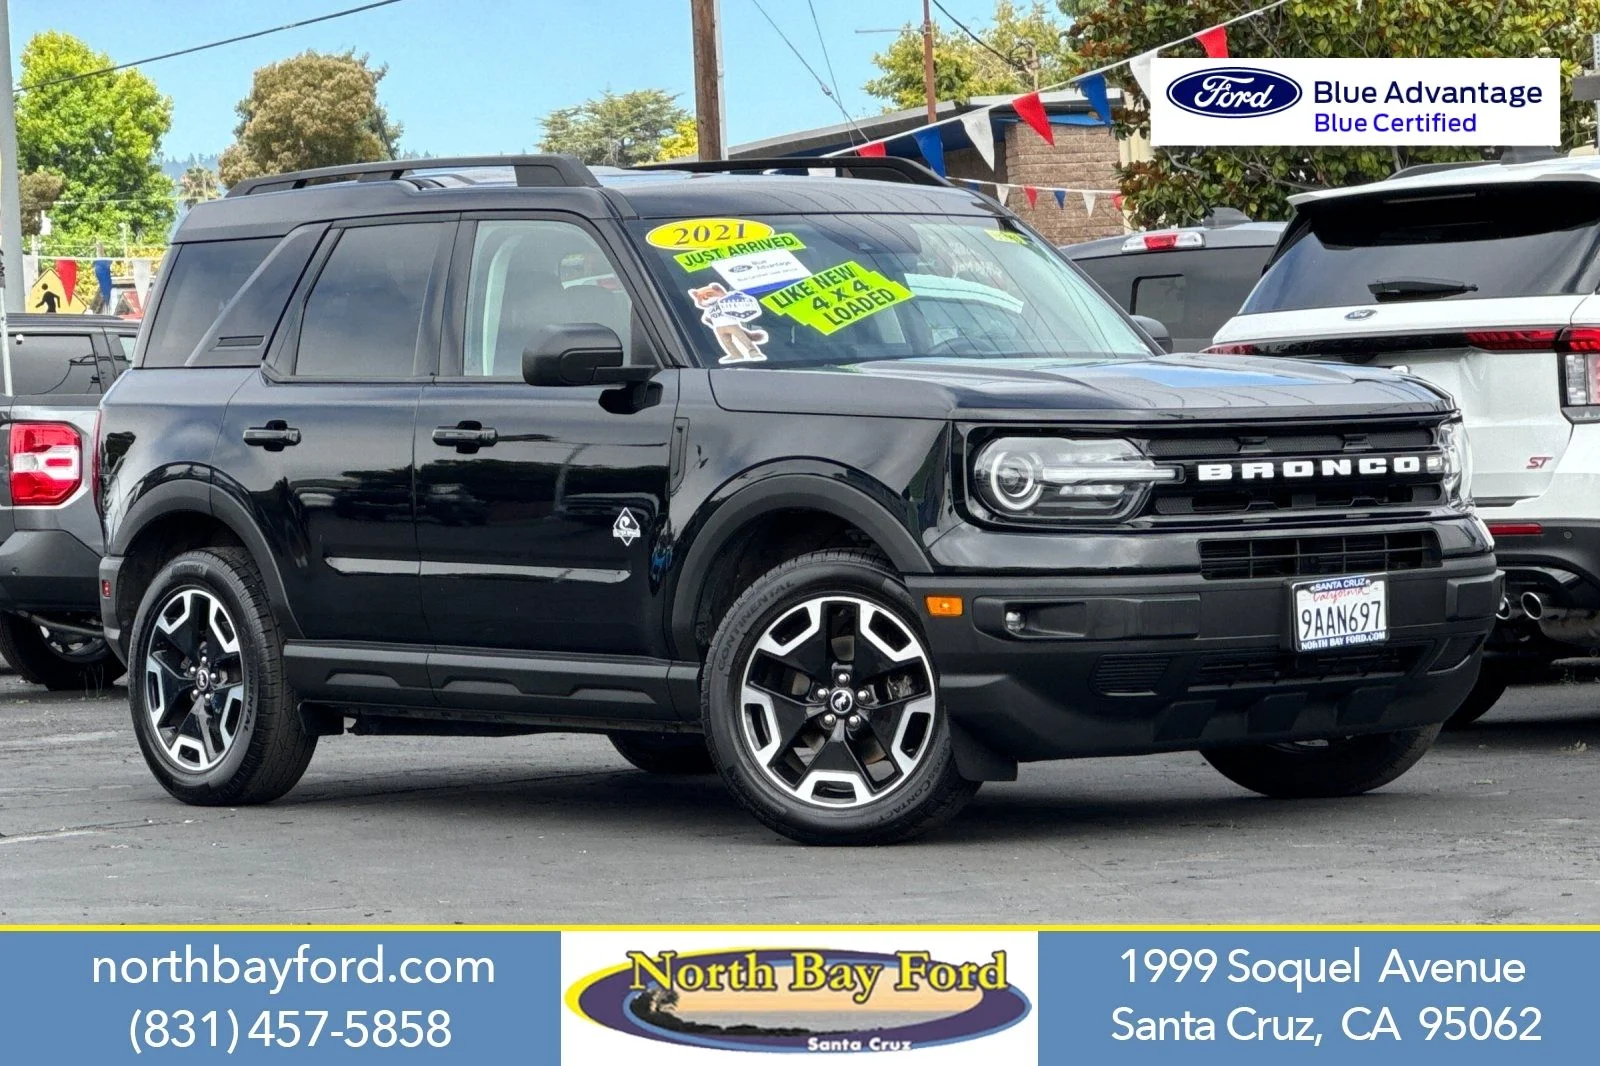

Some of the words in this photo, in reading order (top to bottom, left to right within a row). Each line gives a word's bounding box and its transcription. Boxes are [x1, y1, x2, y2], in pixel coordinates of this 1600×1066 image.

[673, 222, 749, 246] 2021
[684, 249, 725, 267] JUST
[729, 235, 795, 258] ARRIVED
[770, 280, 815, 309] LIKE
[811, 264, 857, 290] NEW
[812, 295, 831, 311] 4
[852, 279, 870, 293] 4
[822, 287, 896, 326] LOADED
[1198, 456, 1420, 481] BRONCO
[1526, 456, 1553, 470] ST
[1315, 581, 1342, 592] SANTA
[1343, 578, 1366, 589] CRUZ
[718, 580, 794, 672] CONTINENTAL
[1301, 600, 1382, 640] 9AAN697
[1301, 639, 1328, 651] NORTH
[1329, 636, 1345, 647] BAY
[1345, 631, 1386, 645] FORD.COM
